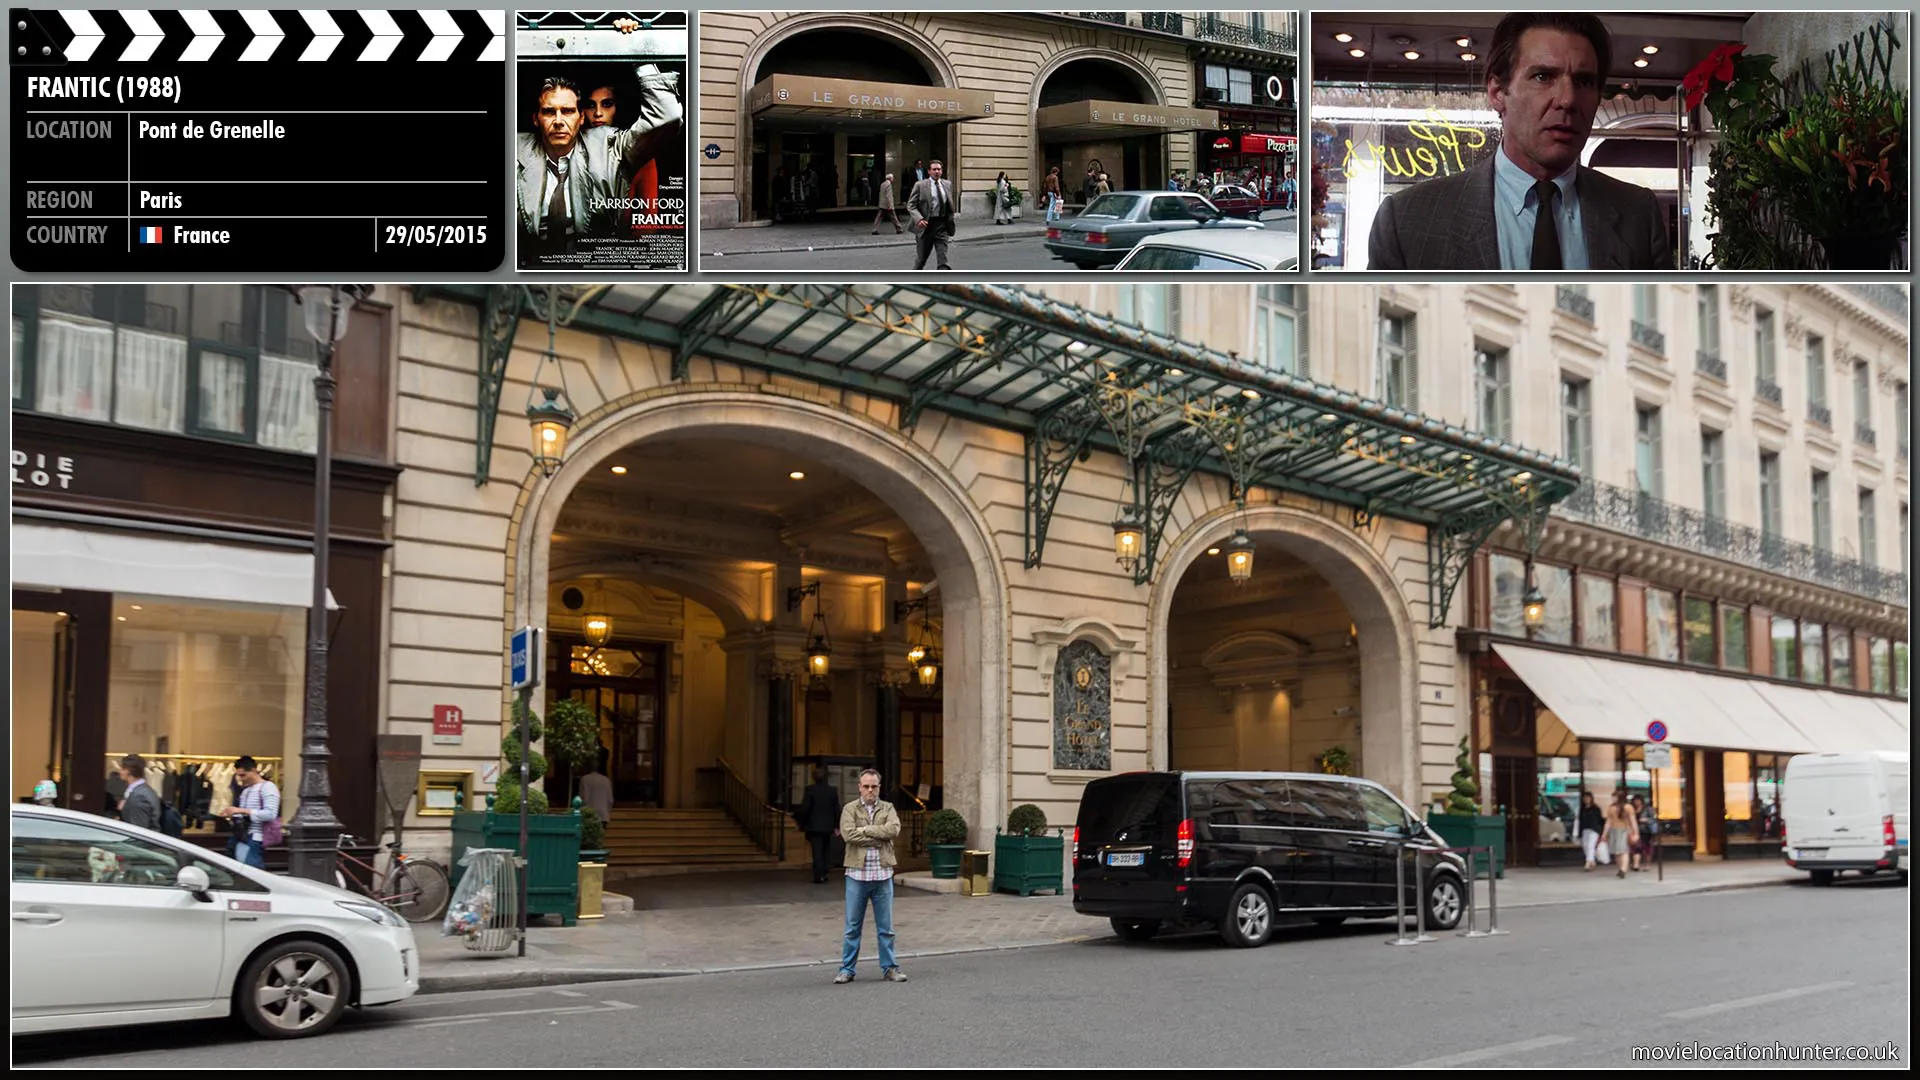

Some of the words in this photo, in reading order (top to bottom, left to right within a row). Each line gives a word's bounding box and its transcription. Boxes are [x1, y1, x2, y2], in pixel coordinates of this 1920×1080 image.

[813, 91, 833, 103] LE
[848, 94, 904, 107] GRAND
[918, 99, 963, 112] HOTEL
[1112, 112, 1125, 122] LE
[1133, 113, 1166, 124] GRAND
[1173, 117, 1201, 127] HOTEL
[1267, 138, 1286, 152] Pizza
[589, 198, 650, 210] HARRISON
[652, 198, 685, 210] FORD
[631, 213, 685, 225] FRANTIC
[446, 710, 459, 722] H
